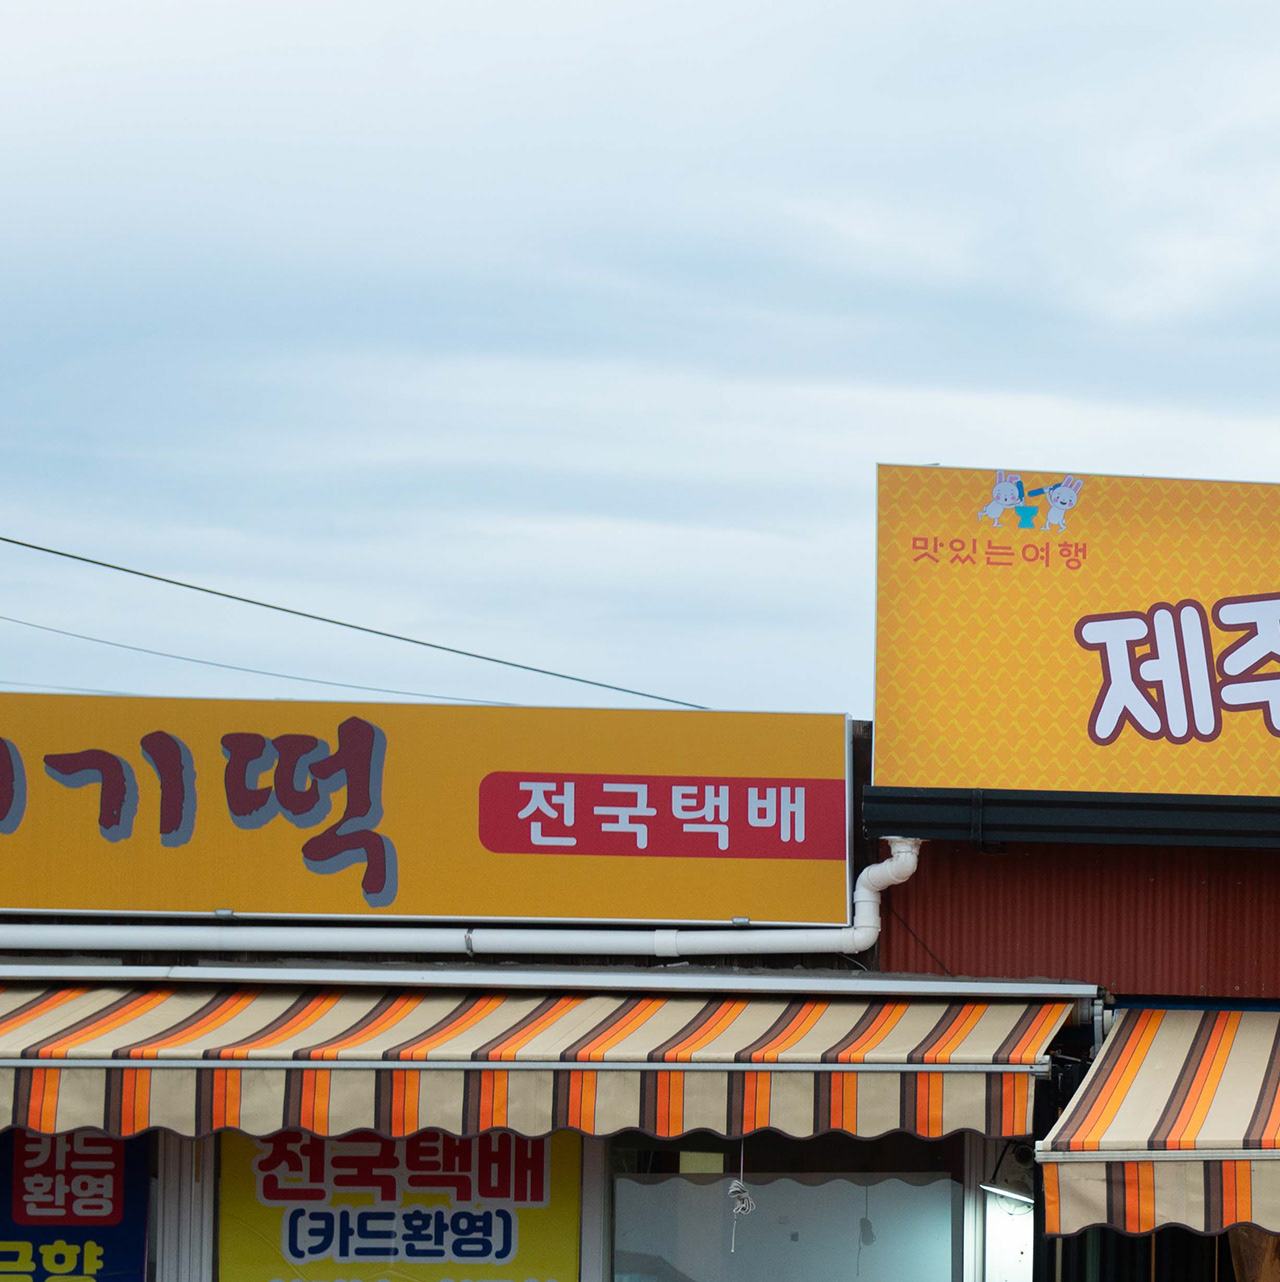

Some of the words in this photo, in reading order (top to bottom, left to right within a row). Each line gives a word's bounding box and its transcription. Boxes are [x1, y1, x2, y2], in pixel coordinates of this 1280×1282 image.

[911, 535, 1089, 571] 맛있는여행
[0, 717, 398, 906] 기떡
[517, 780, 807, 850] 전국택배
[24, 1132, 115, 1171] 카드
[257, 1132, 549, 1203] 전국택배
[23, 1173, 114, 1218] 환영
[287, 1209, 514, 1260] (카드환영)
